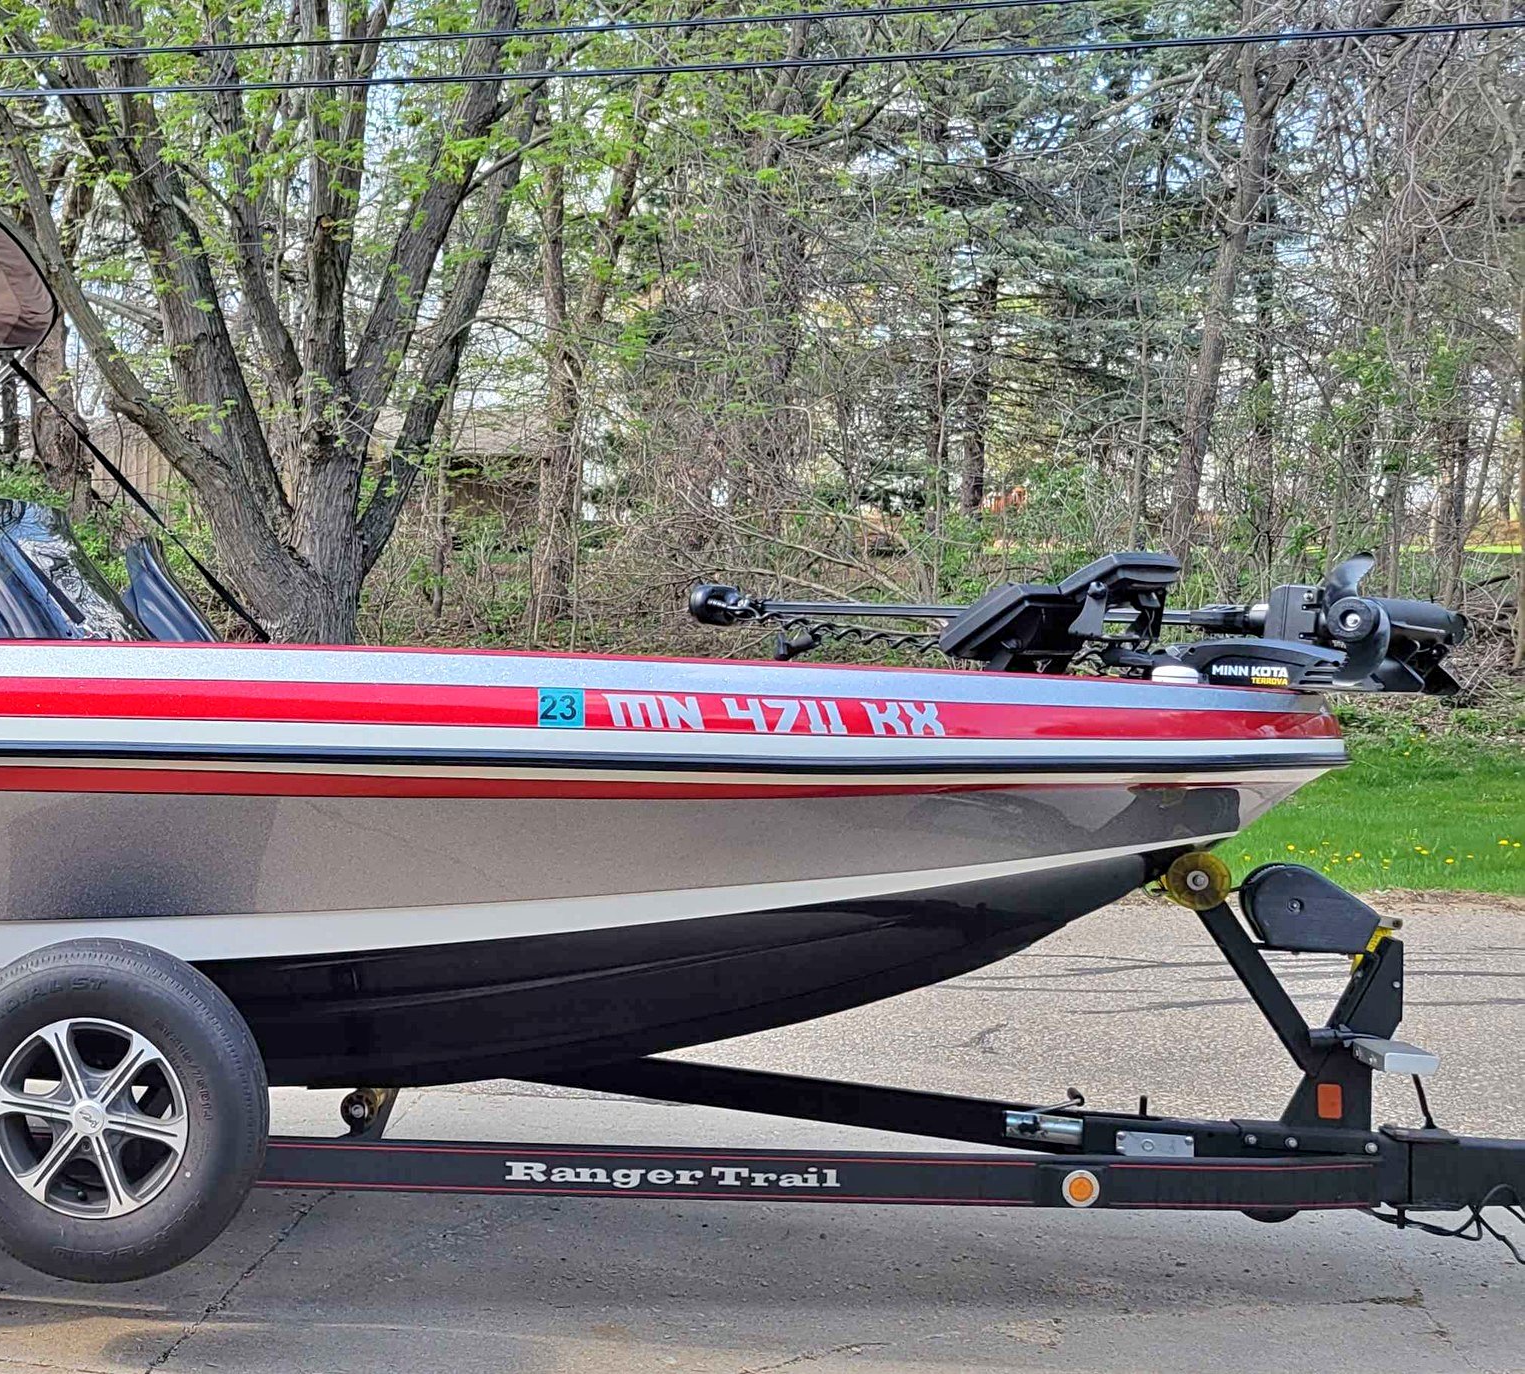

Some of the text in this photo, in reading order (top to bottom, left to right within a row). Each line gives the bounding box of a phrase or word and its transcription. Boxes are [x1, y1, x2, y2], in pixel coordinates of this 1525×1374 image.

[1211, 664, 1289, 678] MINN KOTA
[1251, 677, 1288, 686] TERROVA
[539, 694, 578, 722] 23
[600, 693, 946, 736] MN 4711 KX
[505, 1160, 841, 1189] Ranger Trail
